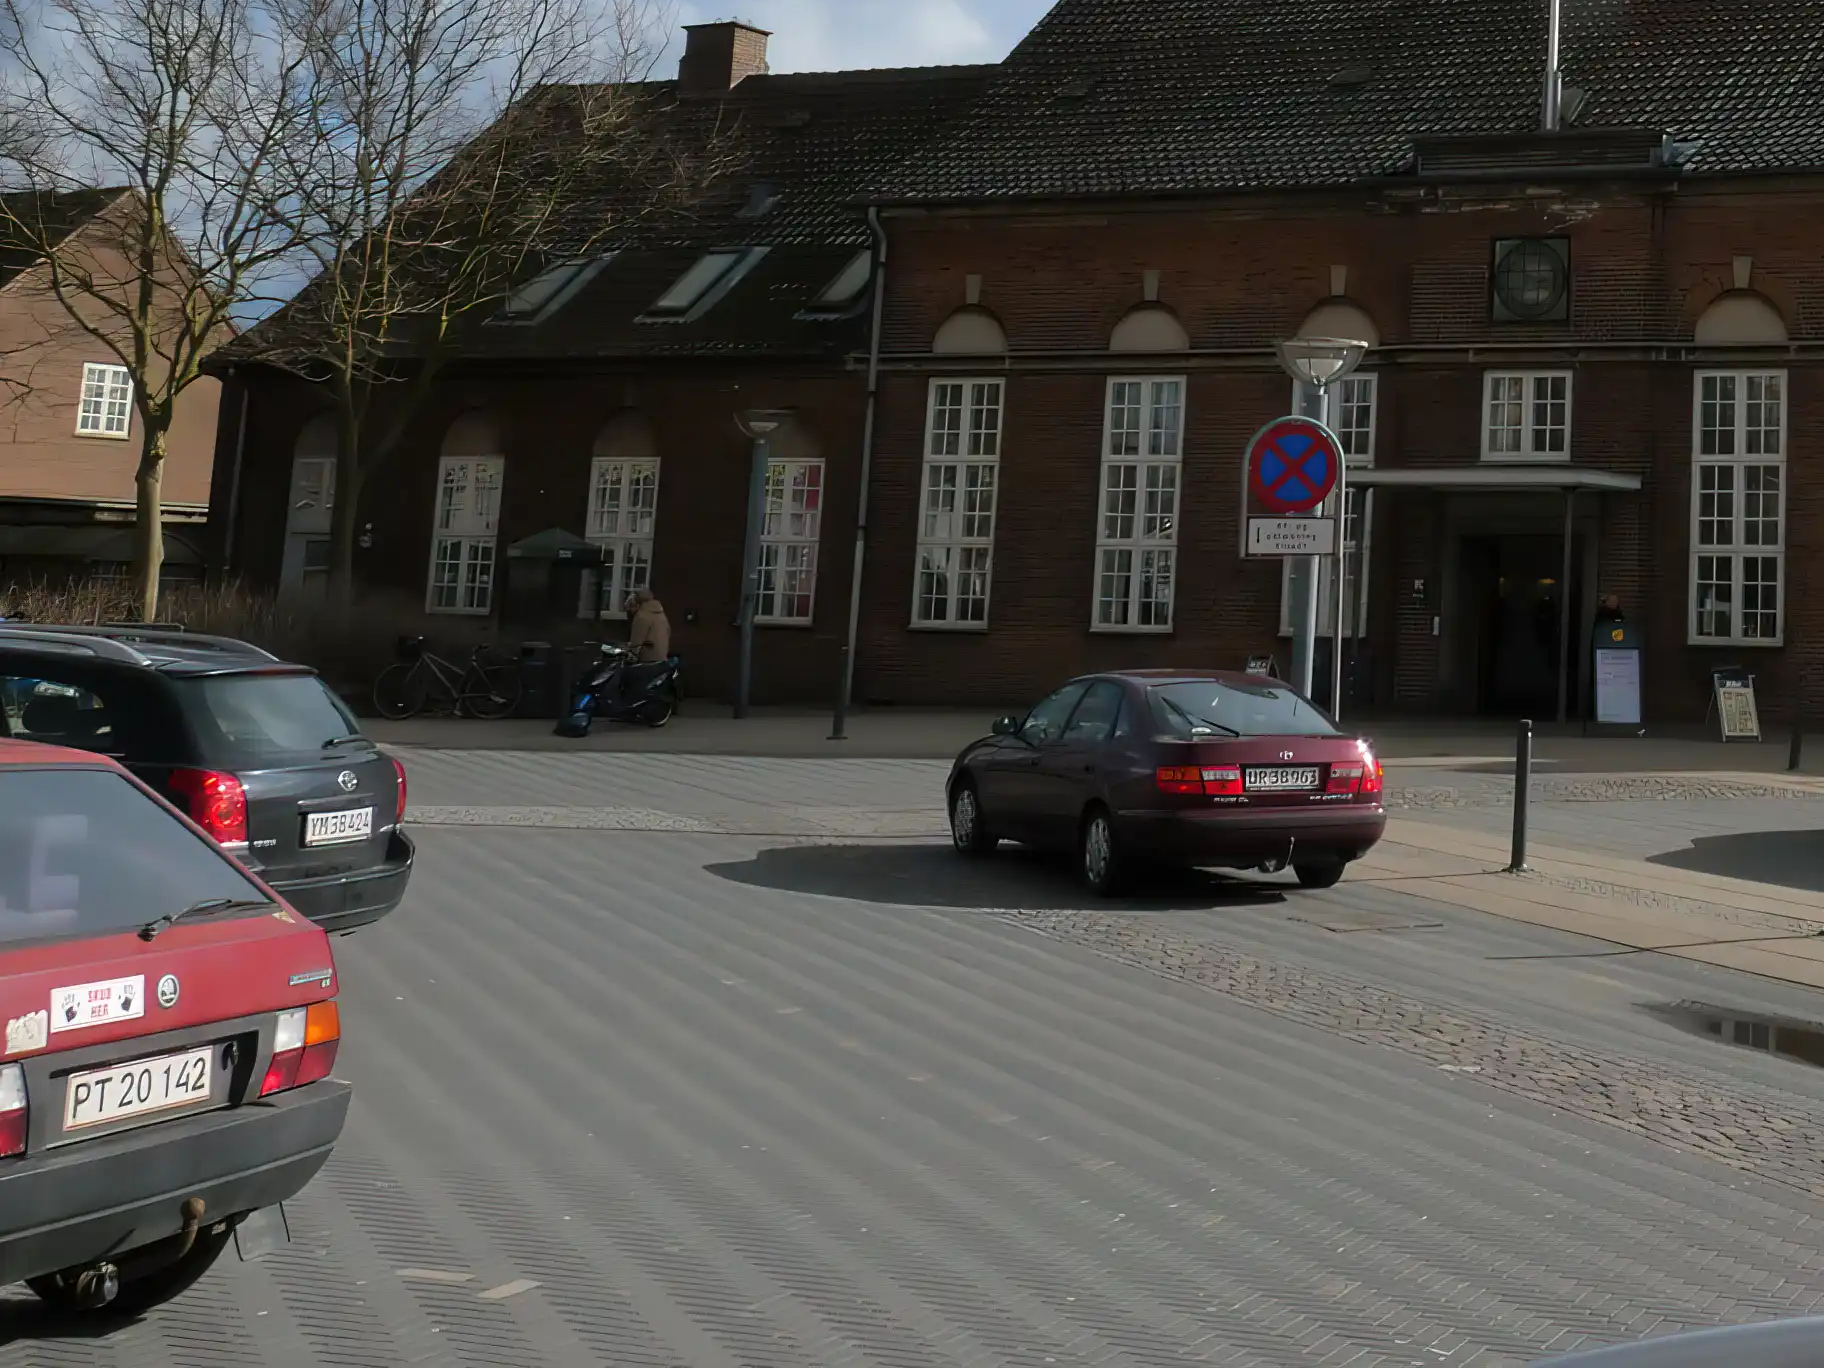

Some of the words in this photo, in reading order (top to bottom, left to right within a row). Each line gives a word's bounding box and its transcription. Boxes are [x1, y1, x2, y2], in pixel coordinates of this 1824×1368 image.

[72, 1077, 113, 1119] PT
[118, 1068, 151, 1108] 20
[163, 1057, 206, 1098] 142
